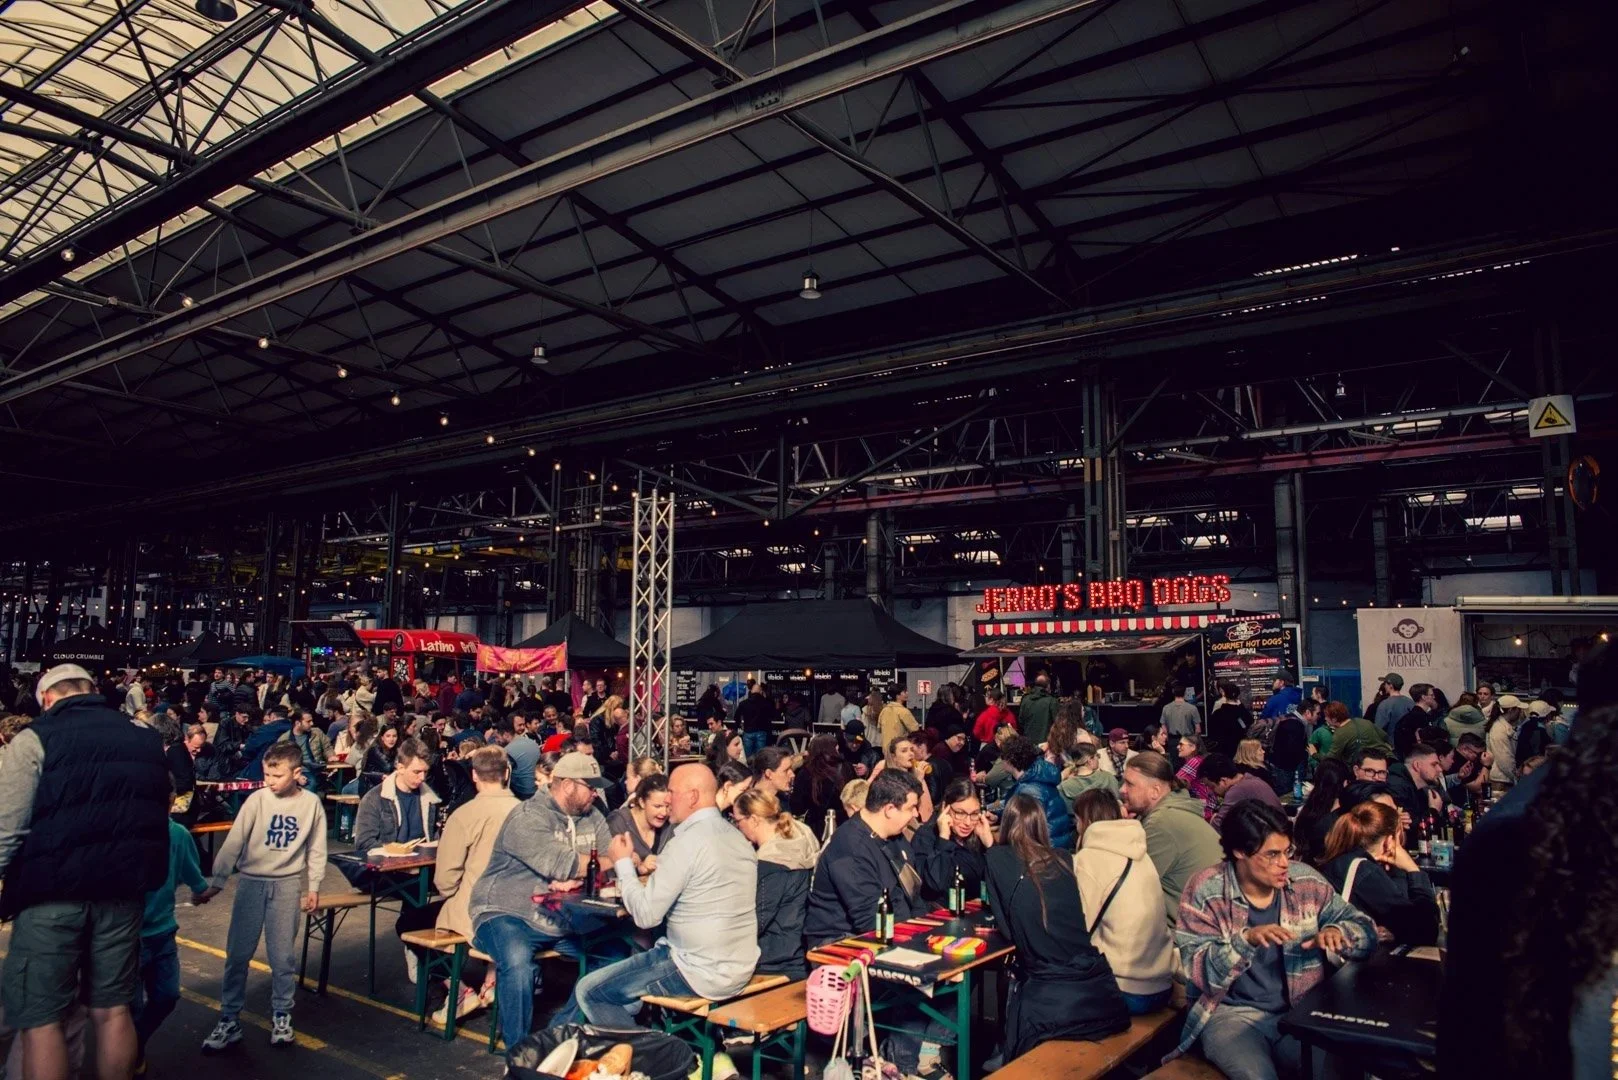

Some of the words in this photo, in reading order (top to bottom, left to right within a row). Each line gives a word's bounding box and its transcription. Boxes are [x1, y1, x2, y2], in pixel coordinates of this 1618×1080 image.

[976, 584, 1082, 613] JERRO'S
[1088, 579, 1143, 610] BBQ
[1152, 574, 1231, 605] DOGS
[420, 638, 455, 653] Latino
[1211, 641, 1244, 651] GOURMET
[1246, 639, 1260, 648] HOT
[1262, 637, 1283, 646] DOGS
[1387, 642, 1432, 654] MELLOW
[75, 653, 105, 661] CRUMBLE
[1237, 648, 1256, 656] MENU
[1387, 654, 1432, 667] MONKEY
[1310, 1010, 1390, 1028] PAPSTAR
